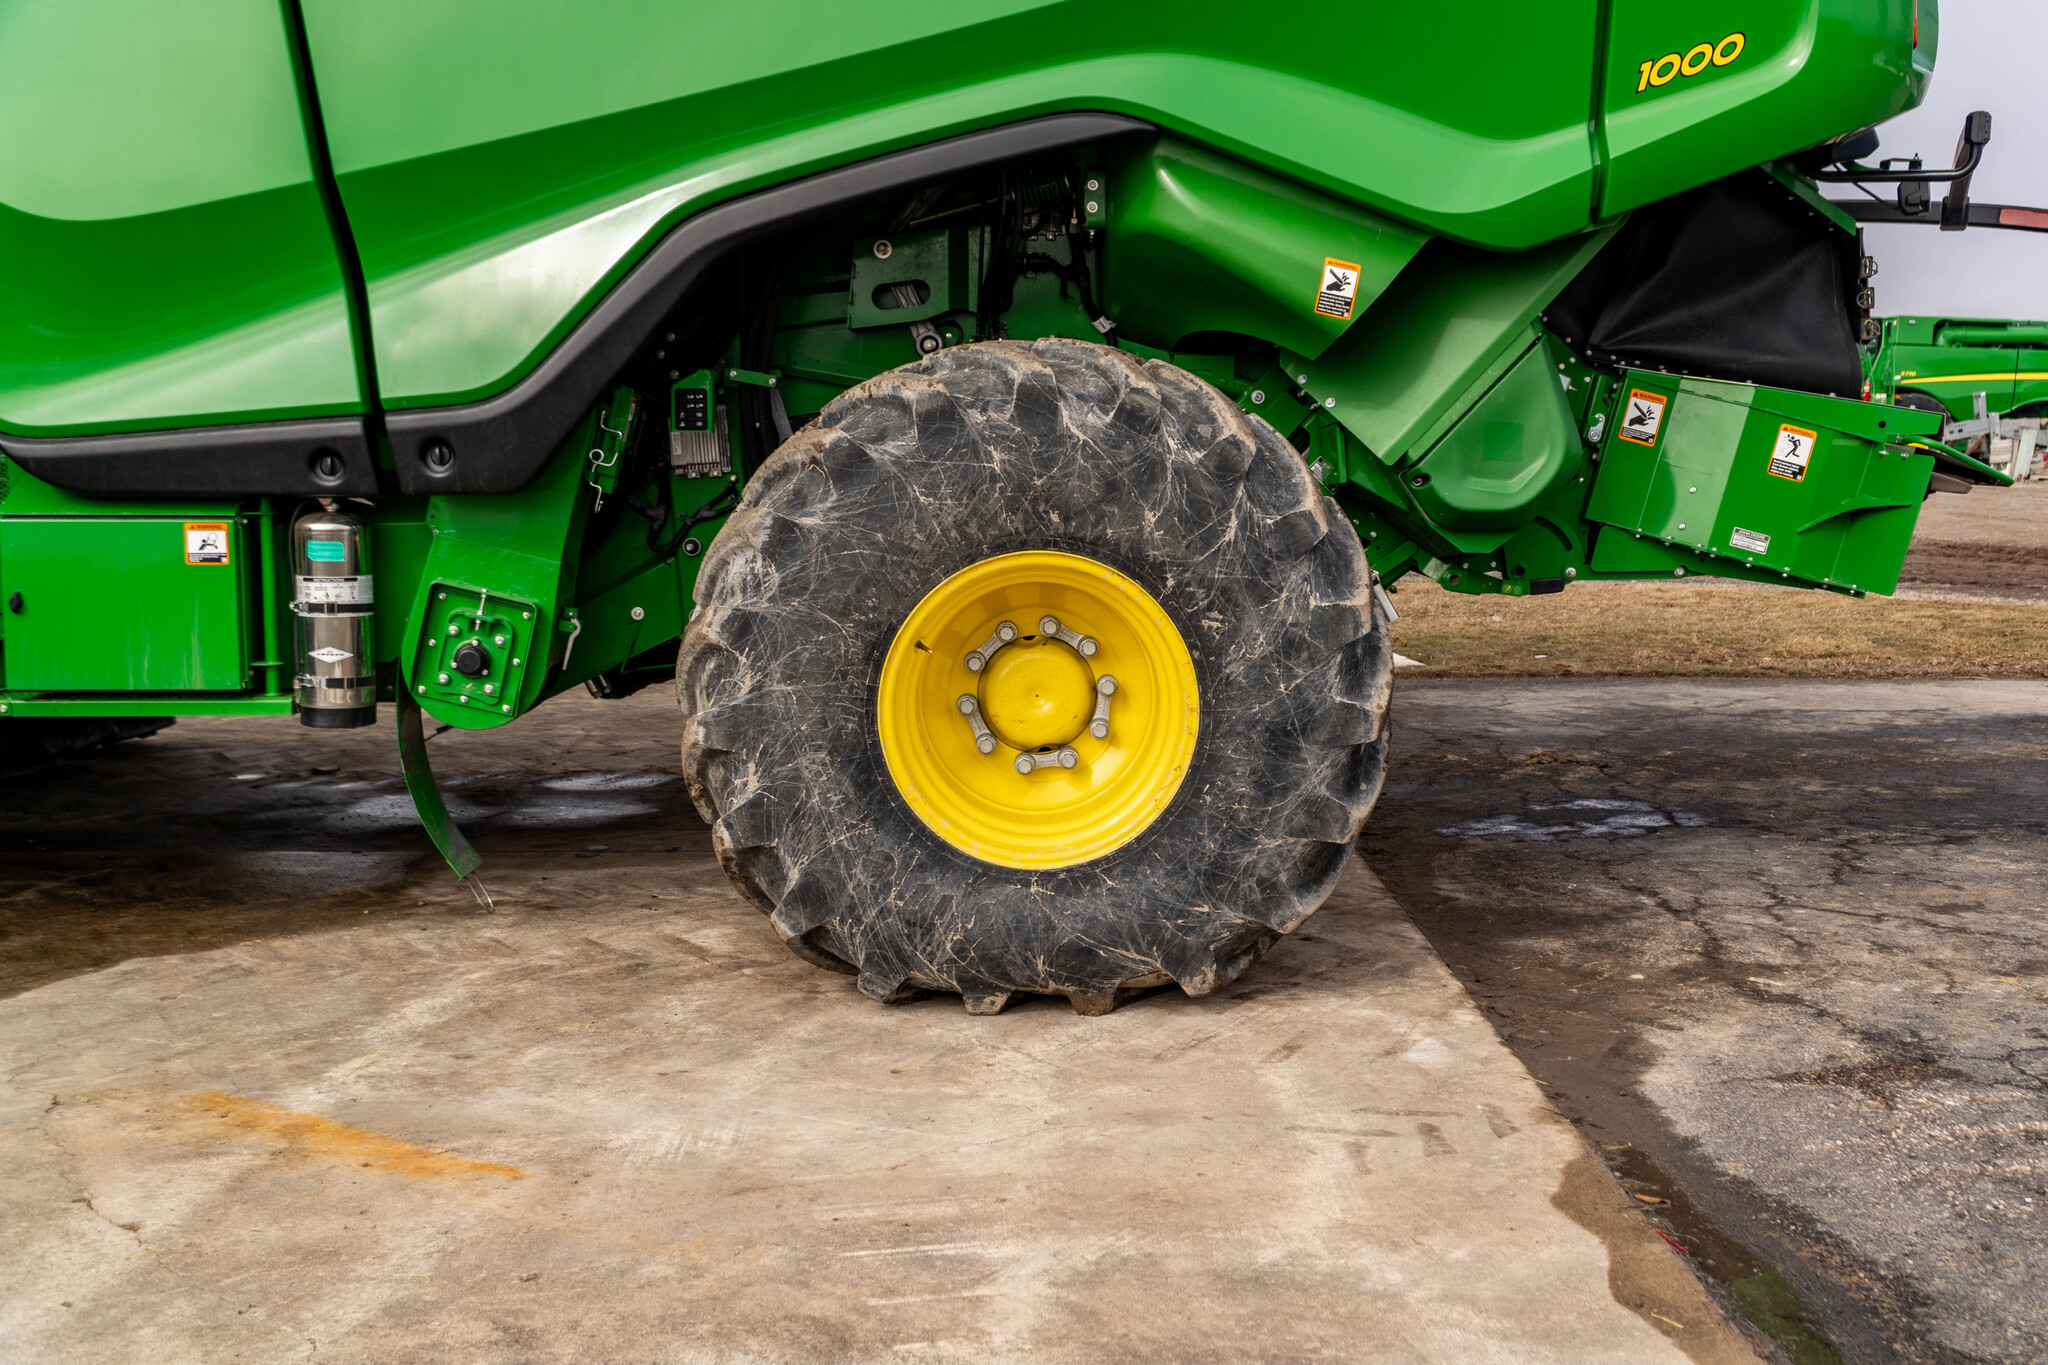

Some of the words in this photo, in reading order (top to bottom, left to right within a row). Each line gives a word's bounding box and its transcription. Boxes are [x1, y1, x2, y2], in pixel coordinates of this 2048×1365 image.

[1636, 32, 1746, 94] 1000
[1639, 392, 1664, 402] WARNING
[1790, 428, 1813, 437] WARNING
